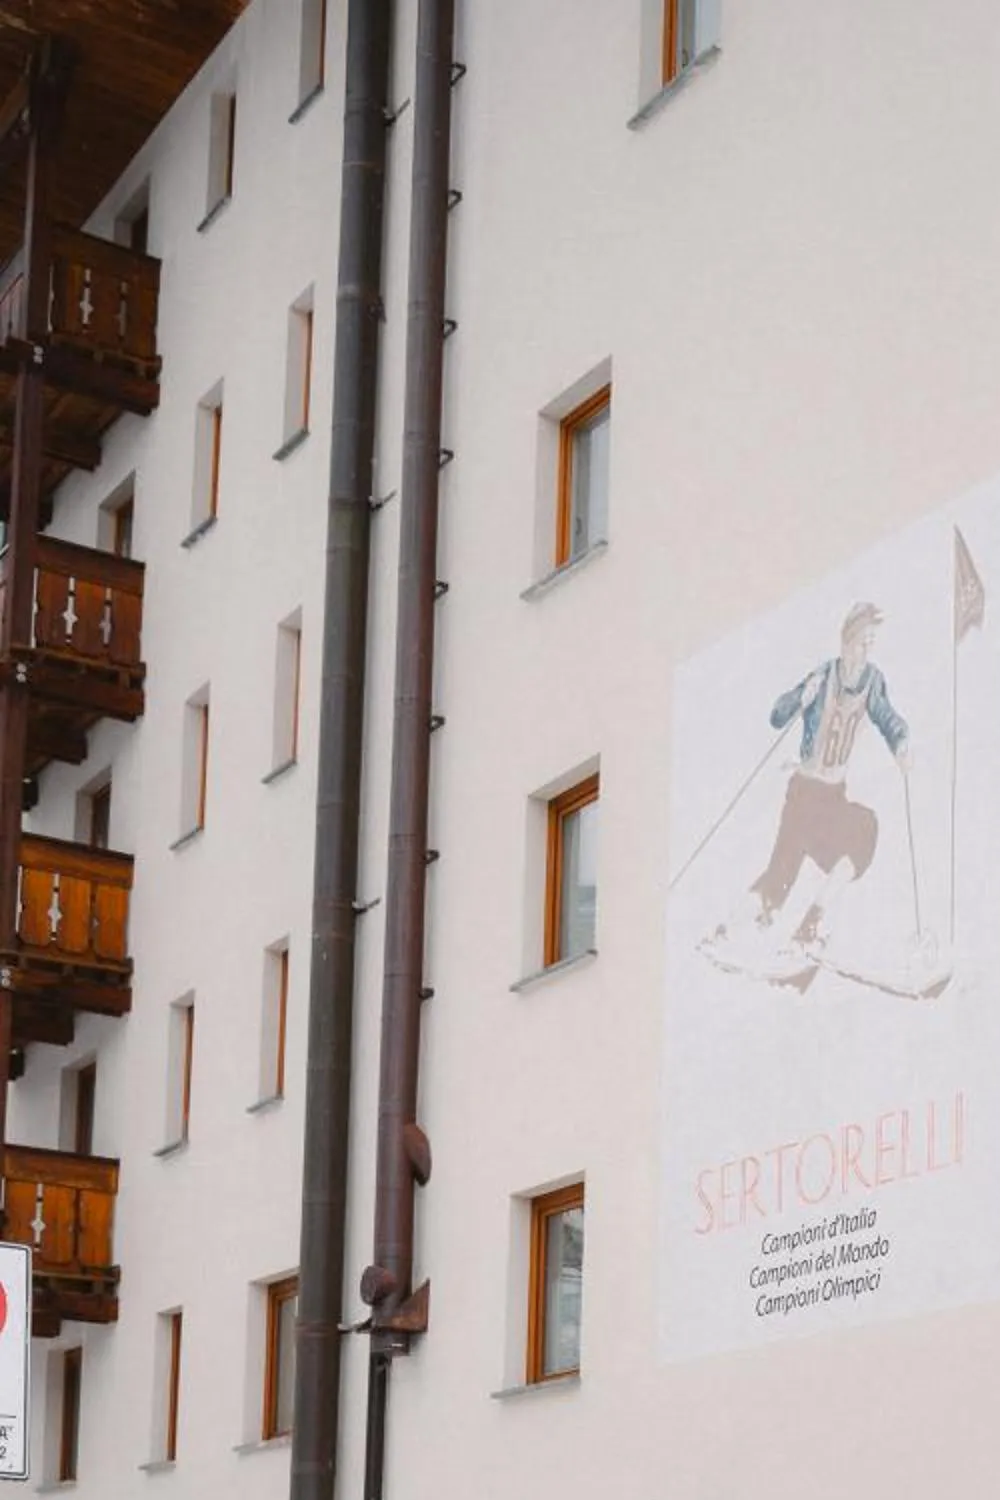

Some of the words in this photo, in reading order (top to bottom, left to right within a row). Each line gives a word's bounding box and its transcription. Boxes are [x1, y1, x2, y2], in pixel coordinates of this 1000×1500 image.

[693, 1087, 966, 1236] SERTORELLI
[761, 1217, 827, 1256] Campioni
[828, 1207, 877, 1240] d'Italia
[749, 1252, 813, 1288] Campioni
[815, 1245, 836, 1272] del
[838, 1235, 890, 1267] Mondo
[755, 1280, 820, 1317] Campioni
[821, 1267, 882, 1302] Olimpici
